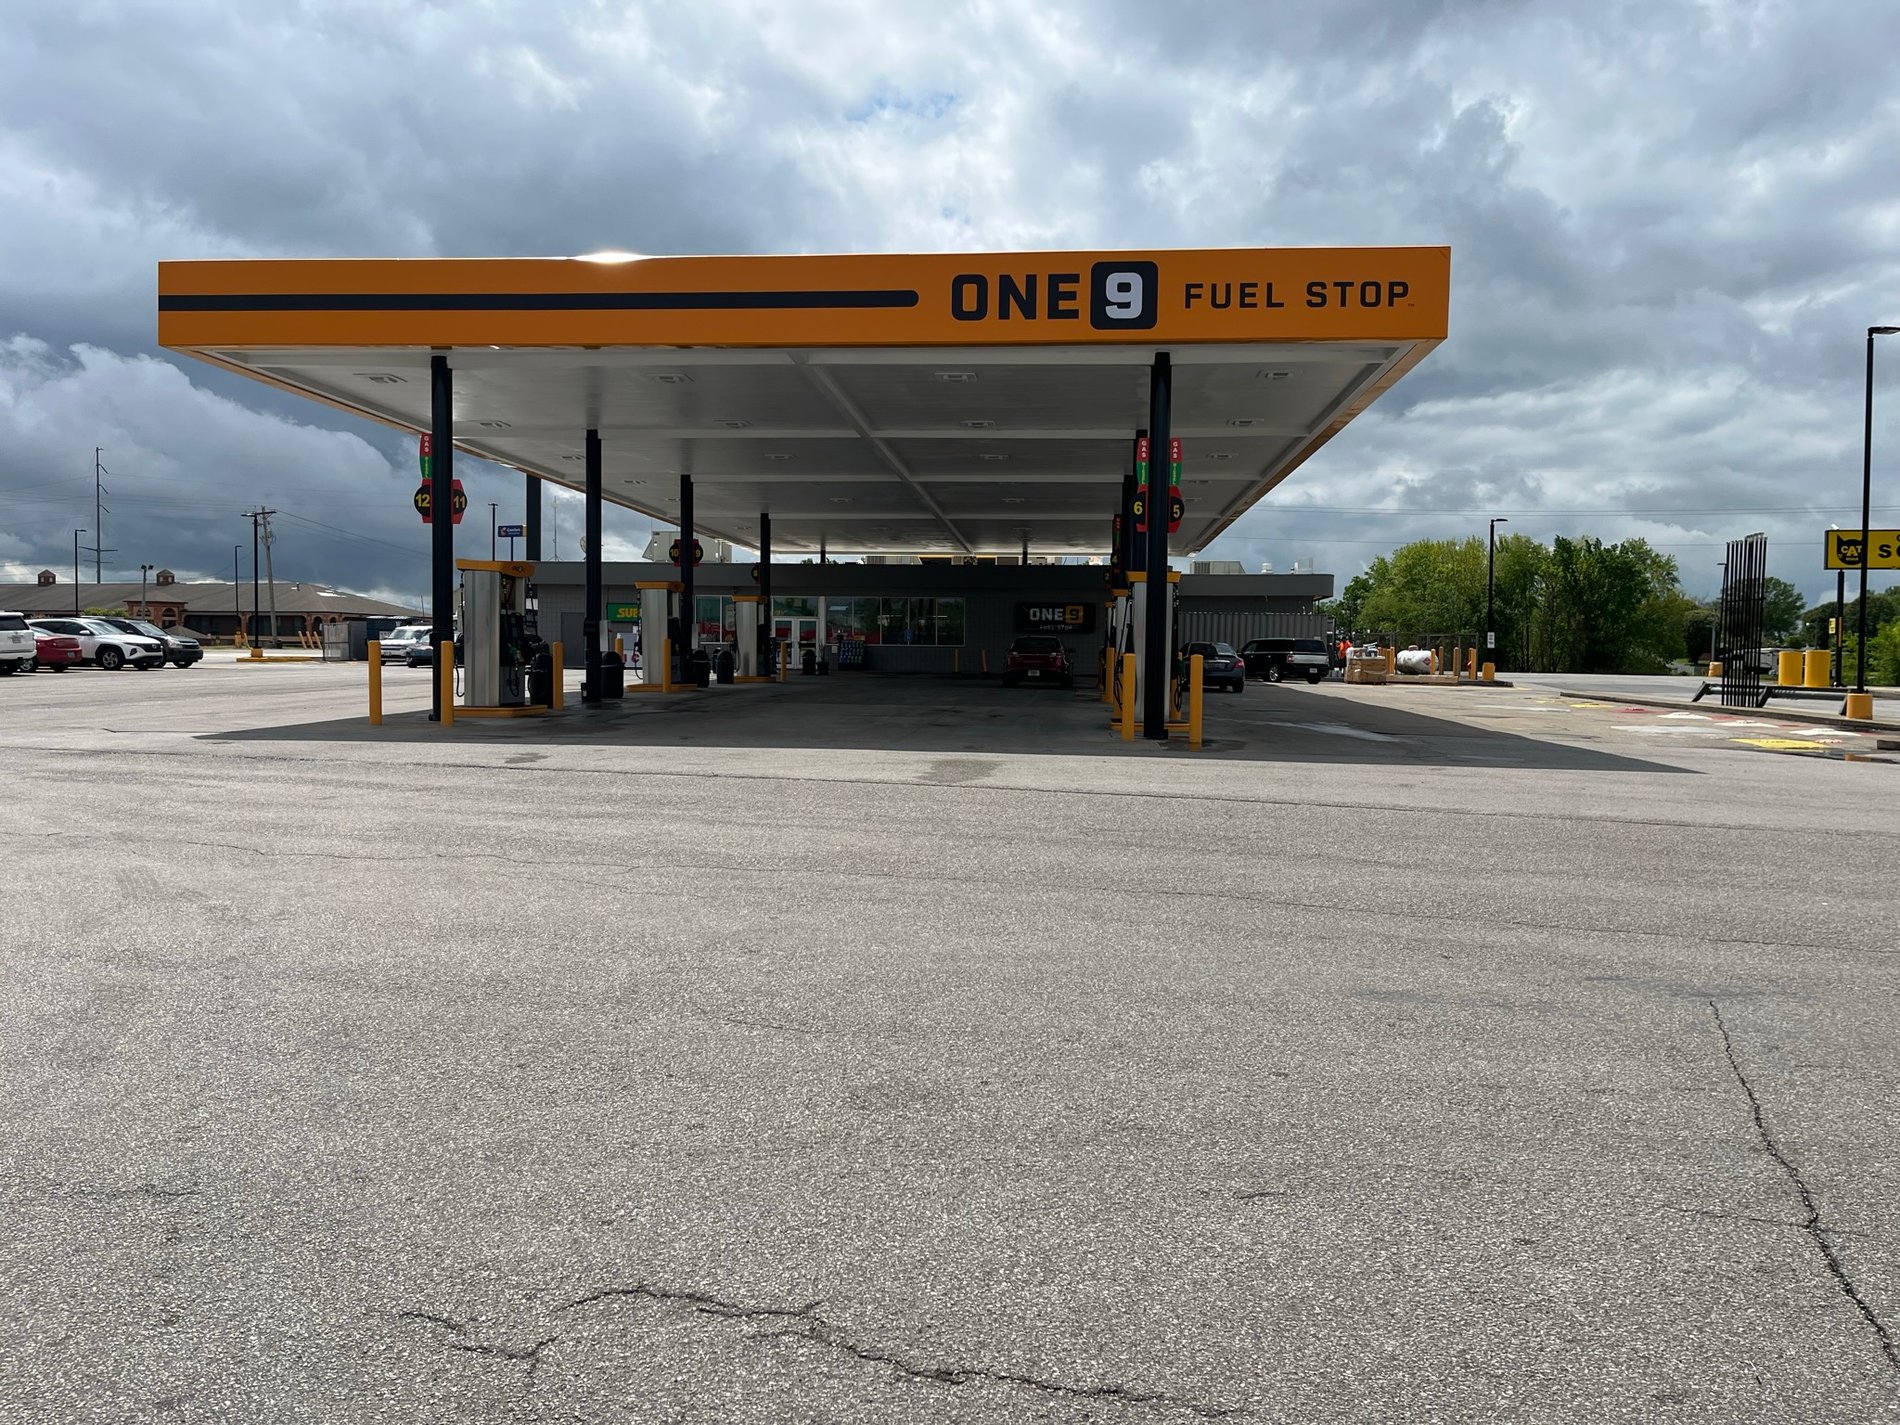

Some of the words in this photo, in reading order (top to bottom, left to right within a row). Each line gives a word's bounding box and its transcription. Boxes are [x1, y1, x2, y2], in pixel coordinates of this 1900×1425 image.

[951, 273, 1080, 321] ONE
[1105, 272, 1143, 320] 9
[1184, 282, 1285, 309] FUEL
[1306, 281, 1409, 308] STOP
[415, 493, 430, 508] 12
[453, 495, 466, 509] 11
[1133, 501, 1143, 515] 6
[1173, 504, 1180, 518] 5
[670, 548, 679, 557] 10
[695, 549, 701, 557] 9
[1840, 545, 1862, 557] CAT
[1029, 607, 1064, 621] ONE
